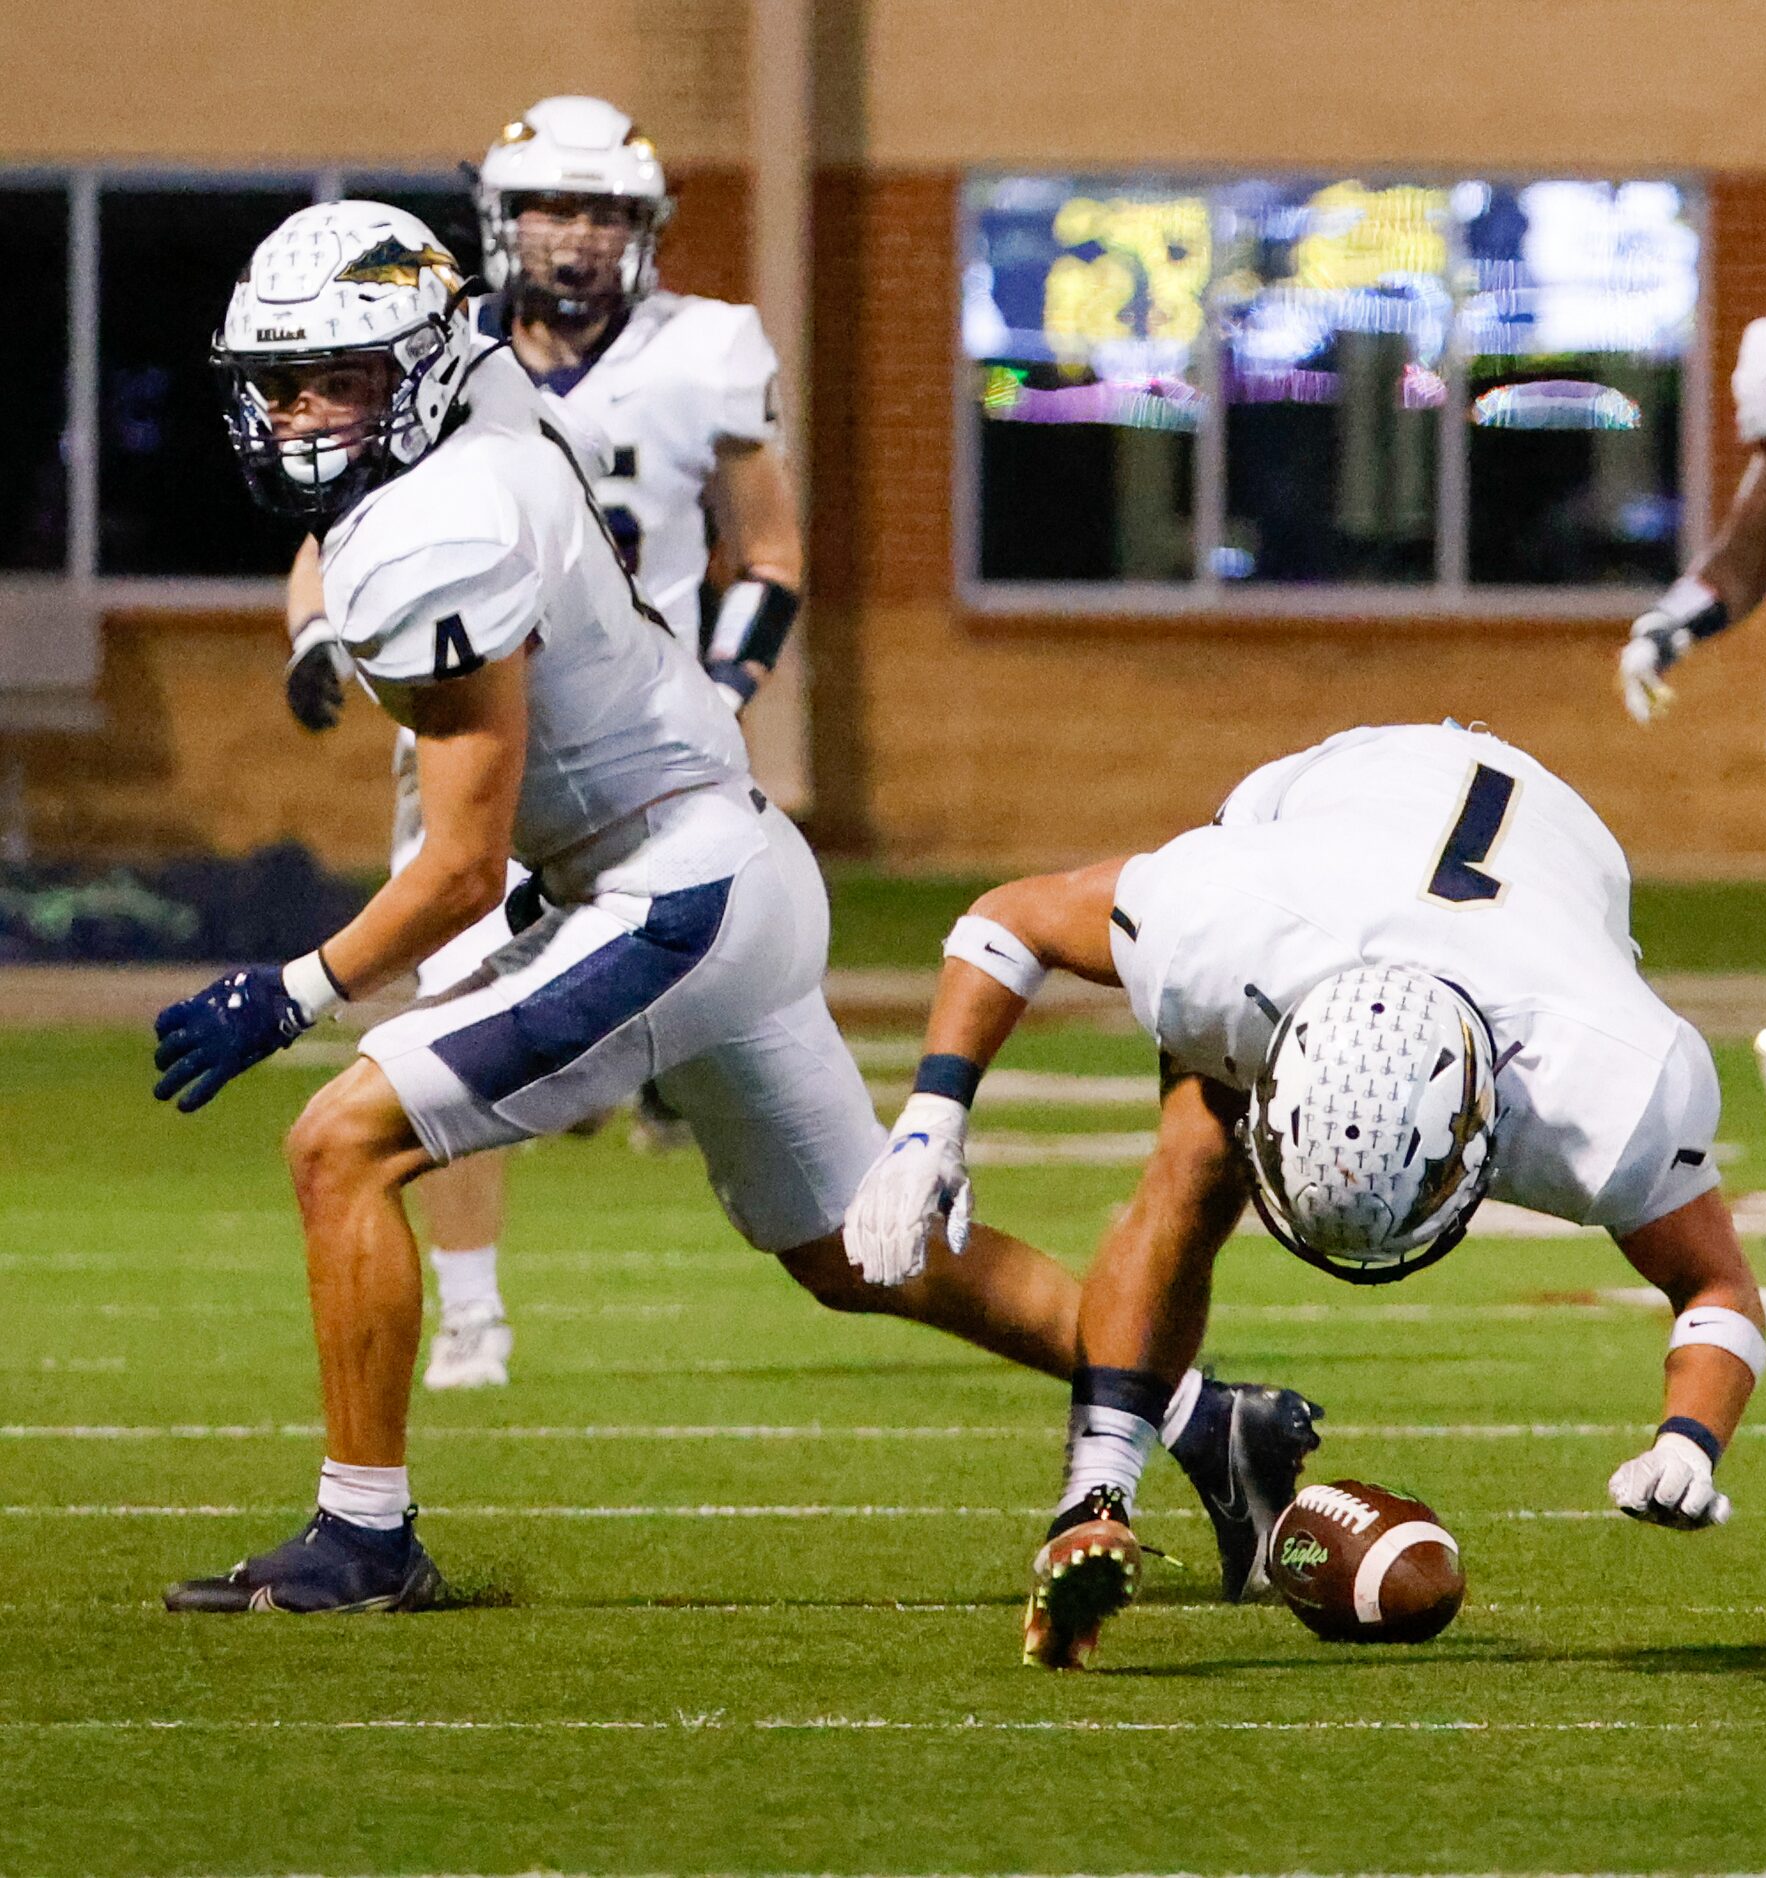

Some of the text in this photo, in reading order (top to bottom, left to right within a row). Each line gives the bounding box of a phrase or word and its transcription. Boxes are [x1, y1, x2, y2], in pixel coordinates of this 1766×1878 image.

[433, 613, 487, 680] 4
[1418, 759, 1525, 911] 1
[1281, 1537, 1328, 1571] Eagles
